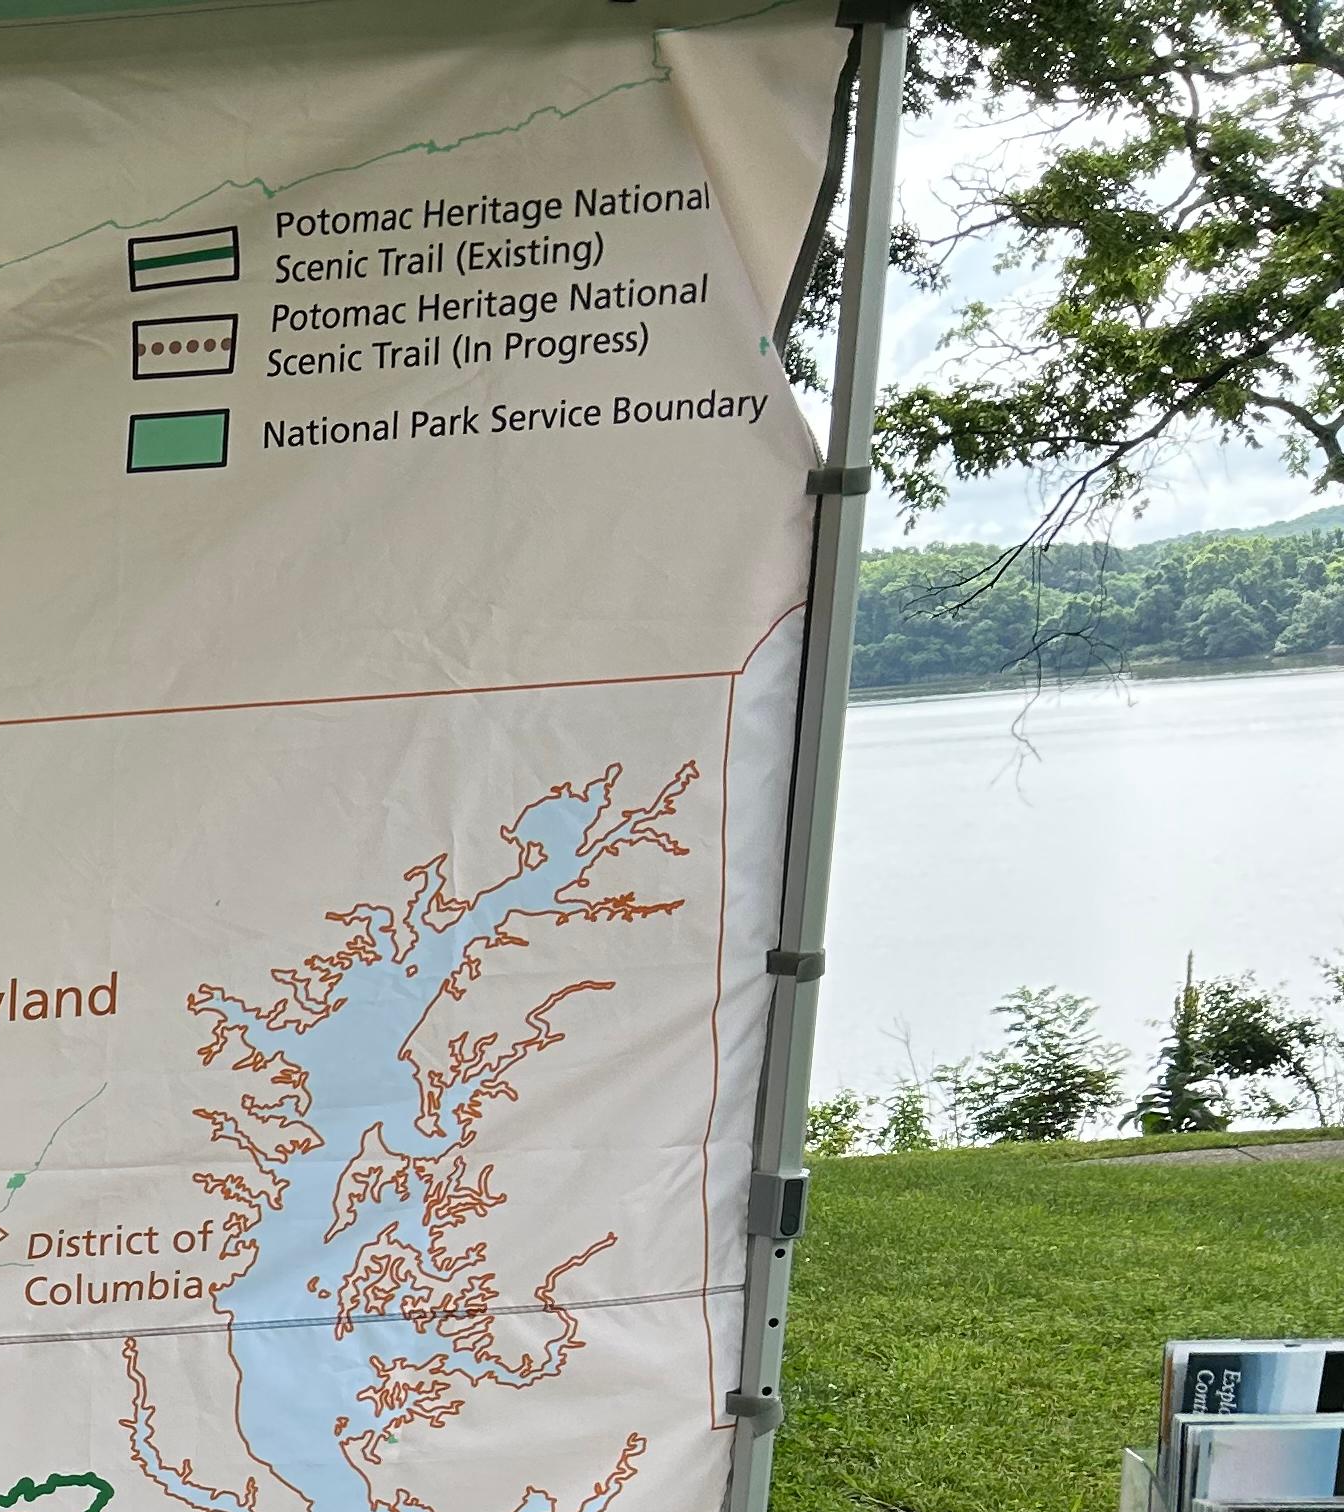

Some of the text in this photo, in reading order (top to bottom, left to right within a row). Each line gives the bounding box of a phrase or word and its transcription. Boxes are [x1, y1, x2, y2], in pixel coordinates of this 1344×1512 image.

[277, 182, 709, 238] Potomac Heritage National
[276, 232, 603, 283] Scenic Trail (Existing)
[272, 273, 707, 332] Potomac Heritage National
[267, 322, 648, 377] Scenic Trail (In Progress)
[264, 389, 768, 448] National Park Service Boundary
[28, 1220, 213, 1259] District of
[25, 1271, 202, 1305] Columbia
